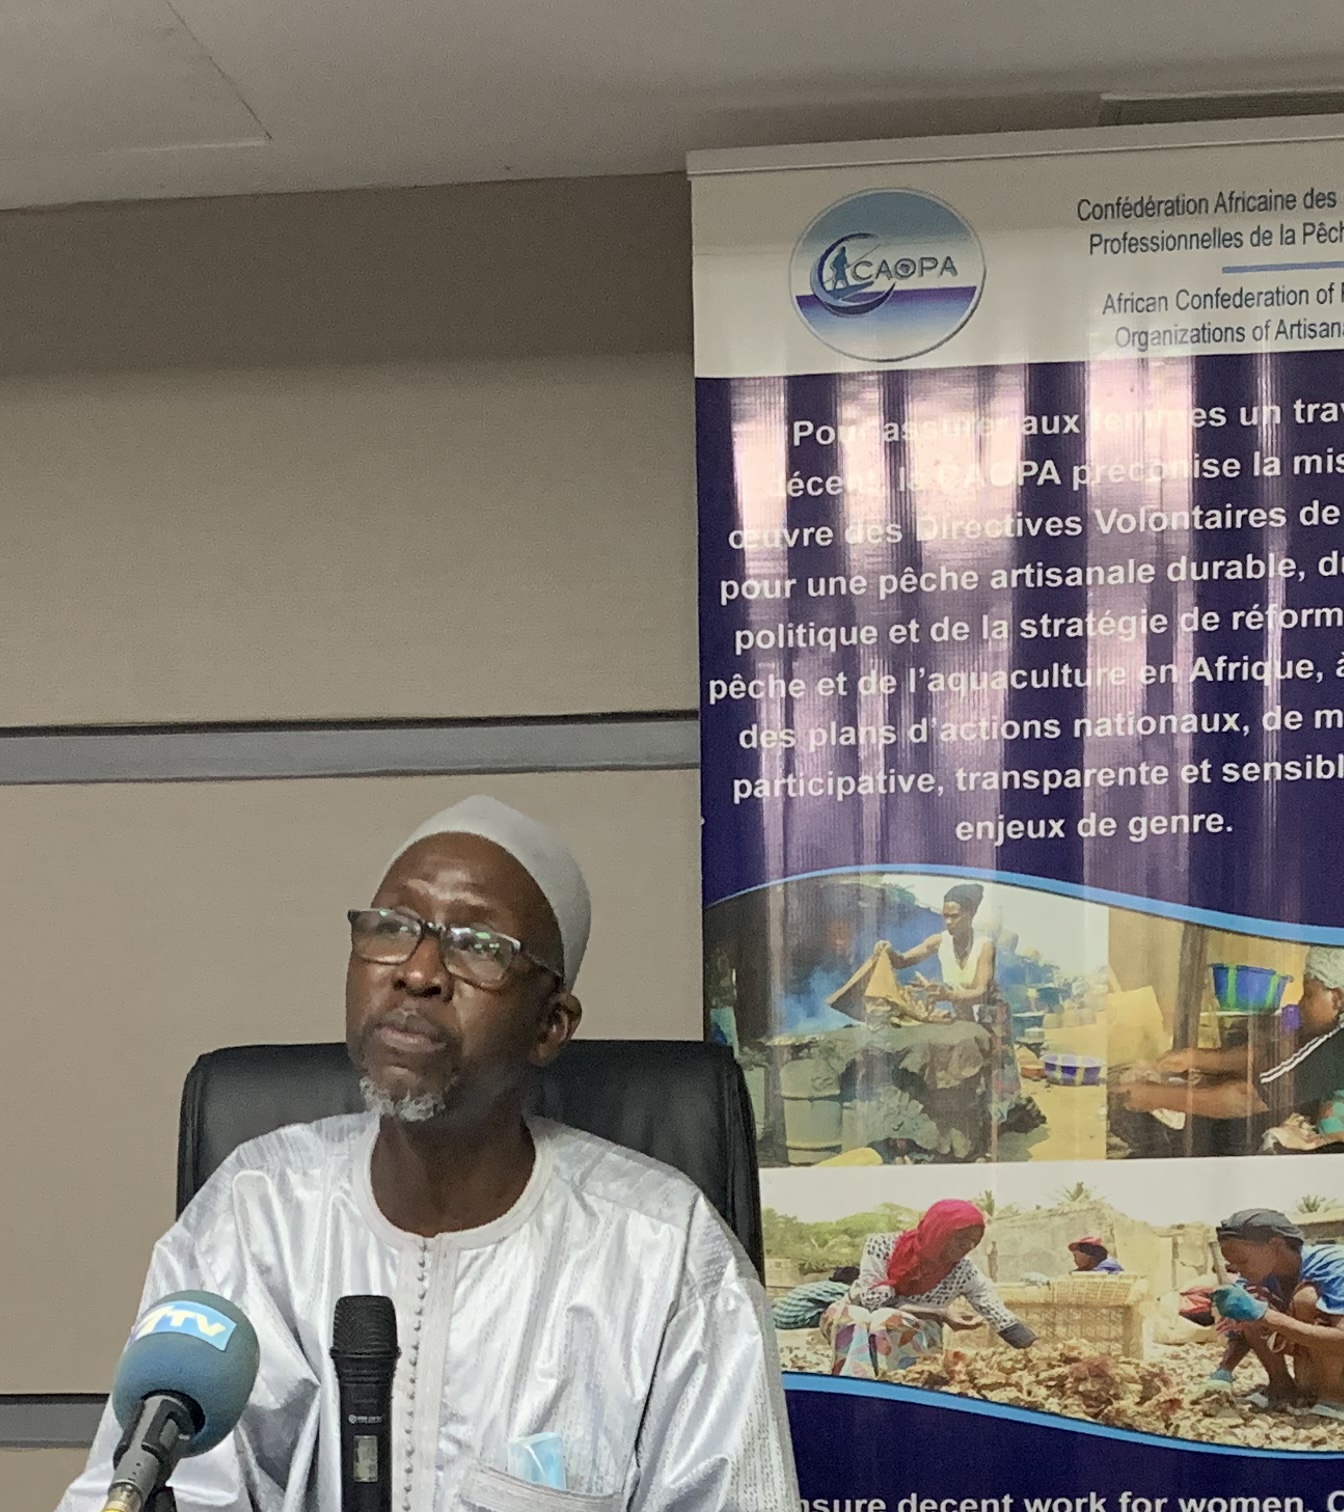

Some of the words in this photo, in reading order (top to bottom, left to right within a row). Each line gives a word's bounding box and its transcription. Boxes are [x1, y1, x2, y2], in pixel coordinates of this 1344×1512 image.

[1078, 194, 1208, 221] Confédération
[1214, 189, 1296, 214] Africaine
[1303, 187, 1337, 210] des
[1090, 226, 1243, 255] Professionnelles
[1250, 224, 1272, 248] de
[1280, 223, 1295, 246] la
[852, 256, 958, 280] CAOPA
[1103, 292, 1168, 315] African
[1176, 286, 1309, 311] Confederation
[1317, 282, 1334, 305] of
[1117, 323, 1245, 352] Organizations
[1252, 319, 1271, 342] of
[1022, 414, 1080, 435] aux
[1096, 503, 1287, 535] Volontaires
[1300, 501, 1341, 526] de
[720, 576, 796, 605] pour
[808, 573, 872, 596] une
[880, 564, 978, 599] pêche
[991, 558, 1155, 589] artisanale
[1168, 553, 1304, 585] durable,
[735, 618, 878, 654] politique
[889, 615, 919, 643] et
[931, 614, 969, 641] de
[982, 613, 1010, 640] la
[1021, 608, 1167, 641] stratégie
[1181, 606, 1220, 633] de
[710, 671, 805, 706] pêche
[816, 669, 846, 696] et
[859, 668, 896, 695] de
[1140, 665, 1178, 686] en
[1191, 656, 1324, 689] Afrique,
[740, 724, 795, 751] des
[810, 721, 895, 754] plans
[1075, 711, 1249, 740] nationaux,
[1262, 706, 1302, 733] de
[734, 765, 943, 802] participative,
[956, 758, 1168, 794] transparente
[1180, 757, 1211, 784] et
[956, 814, 1064, 846] enjeux
[1078, 811, 1116, 838] de
[1129, 813, 1232, 842] genre.
